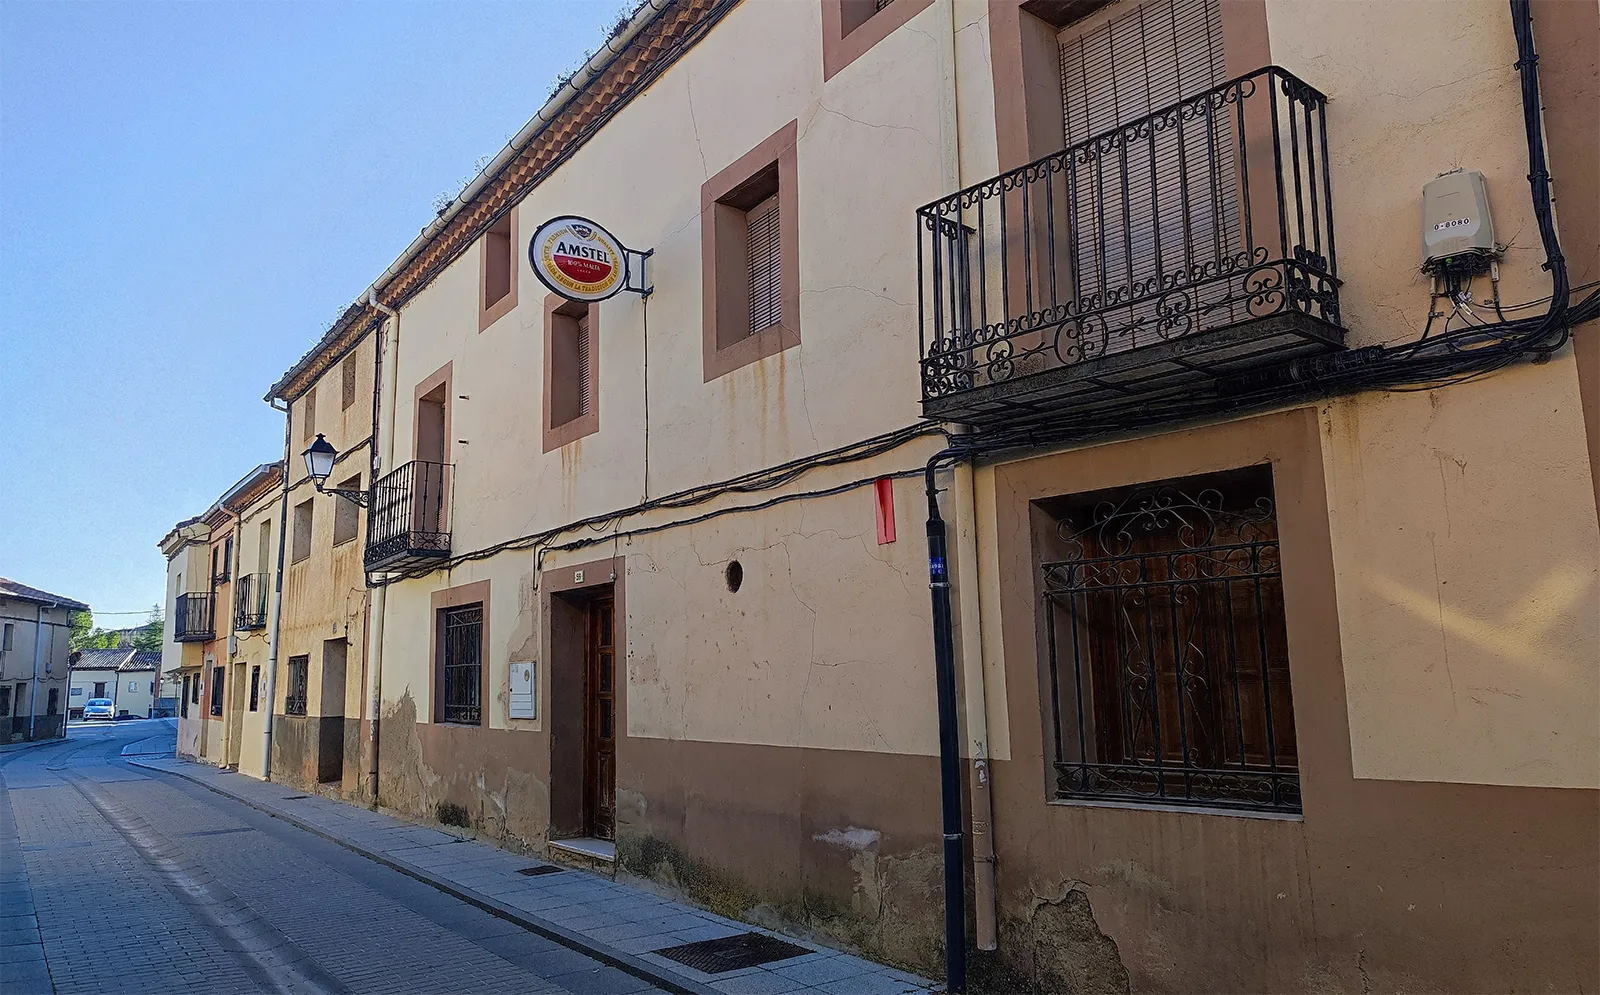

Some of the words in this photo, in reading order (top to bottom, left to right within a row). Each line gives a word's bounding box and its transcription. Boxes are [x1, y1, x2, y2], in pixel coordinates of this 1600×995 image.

[1434, 218, 1470, 231] 0-8080
[556, 242, 610, 264] AMSTEL
[567, 259, 583, 268] 100%
[583, 262, 601, 272] MALTA
